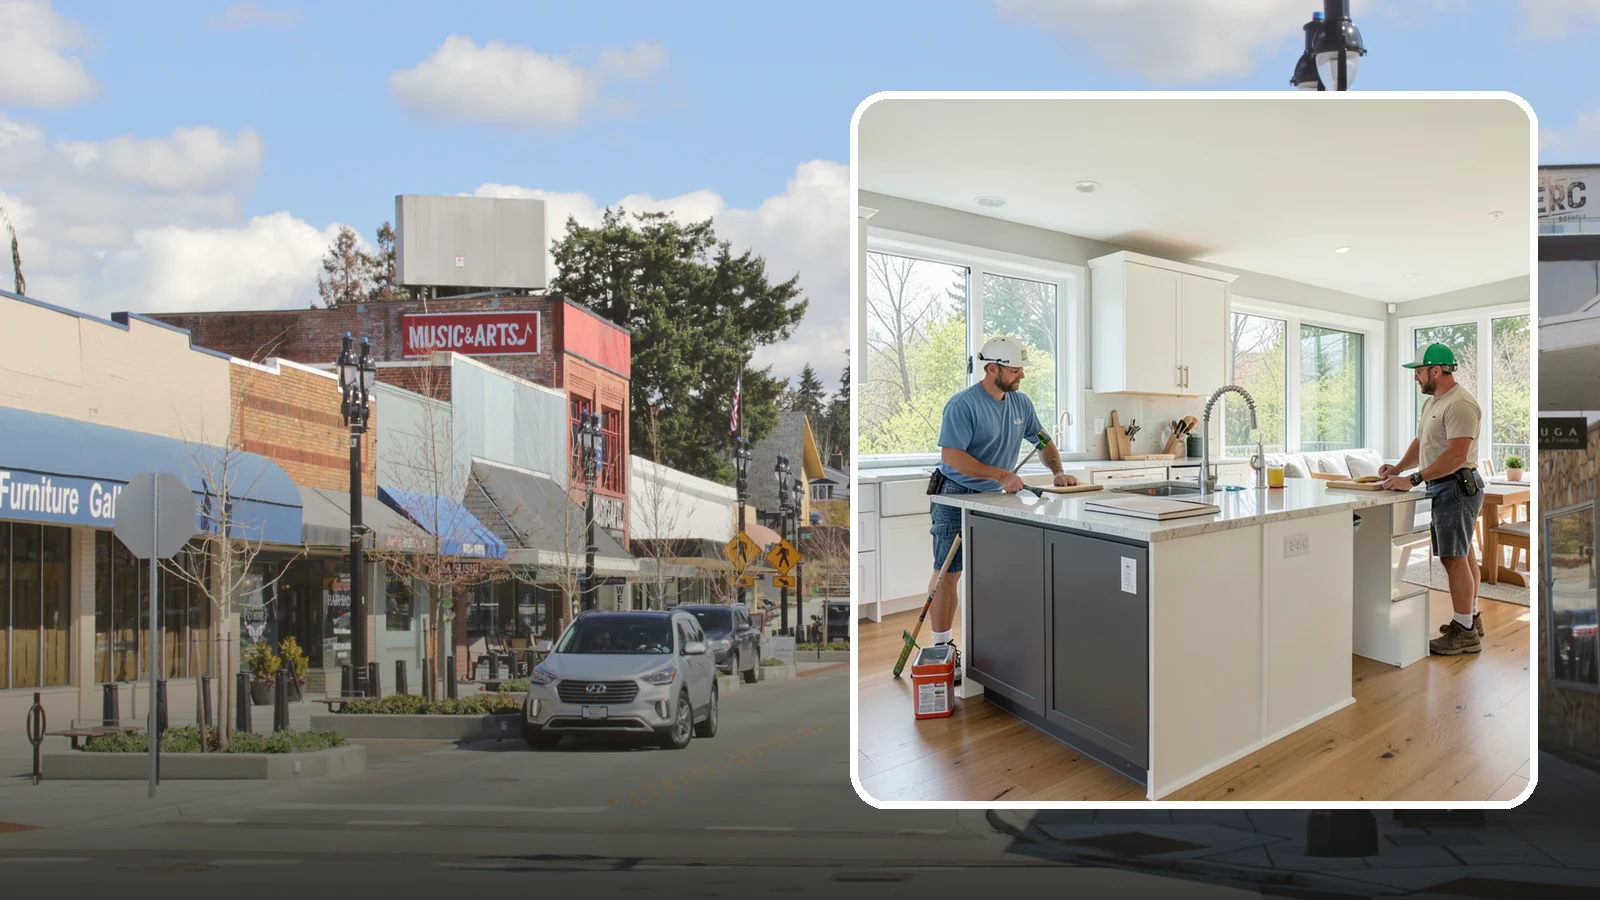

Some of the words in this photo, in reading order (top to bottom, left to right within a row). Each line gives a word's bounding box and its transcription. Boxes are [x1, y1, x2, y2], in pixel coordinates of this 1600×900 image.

[408, 323, 520, 348] MUSIC&ARTS
[0, 471, 79, 515] Furniture
[453, 563, 480, 574] SUSHI
